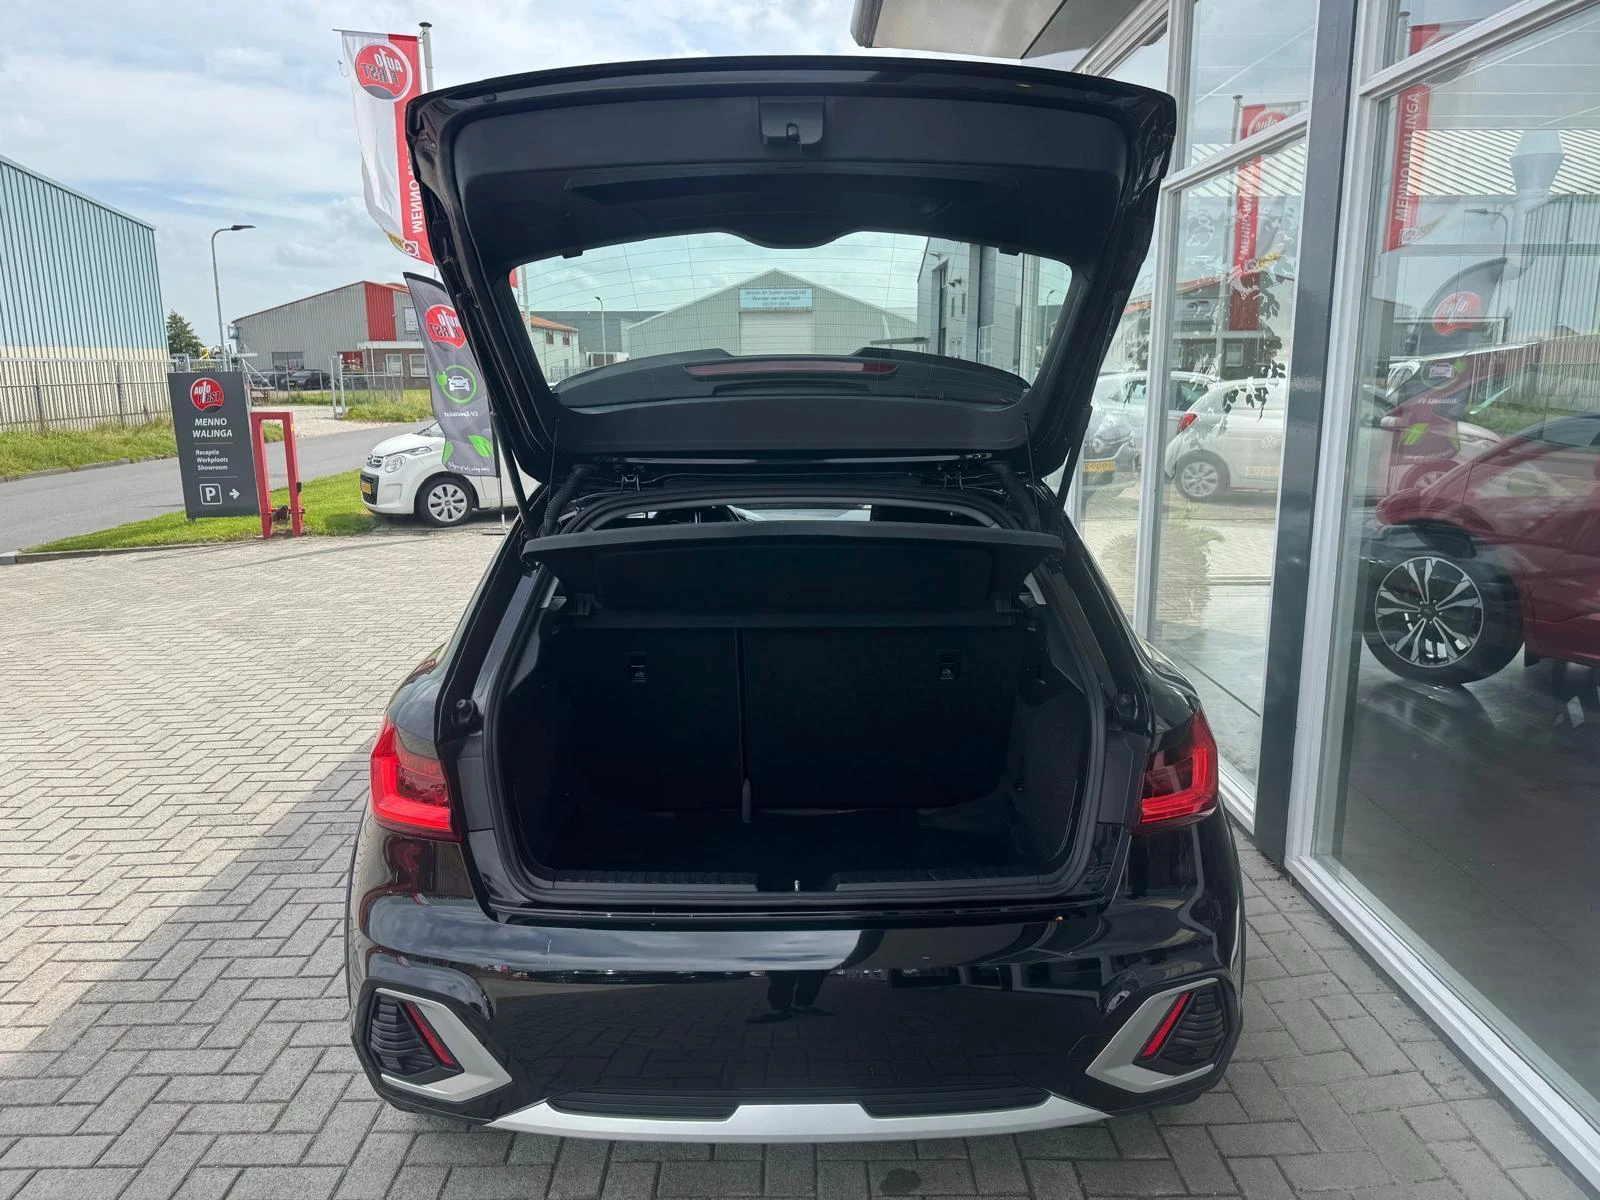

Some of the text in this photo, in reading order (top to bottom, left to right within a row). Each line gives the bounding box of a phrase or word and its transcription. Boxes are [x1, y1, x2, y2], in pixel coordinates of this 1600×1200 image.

[194, 381, 211, 395] AUTO
[194, 417, 227, 427] MENNO
[192, 429, 233, 439] WALINGA
[195, 449, 220, 457] Receptie
[196, 456, 229, 464] Werkplaats
[197, 464, 229, 472] Showroom
[205, 487, 216, 502] P
